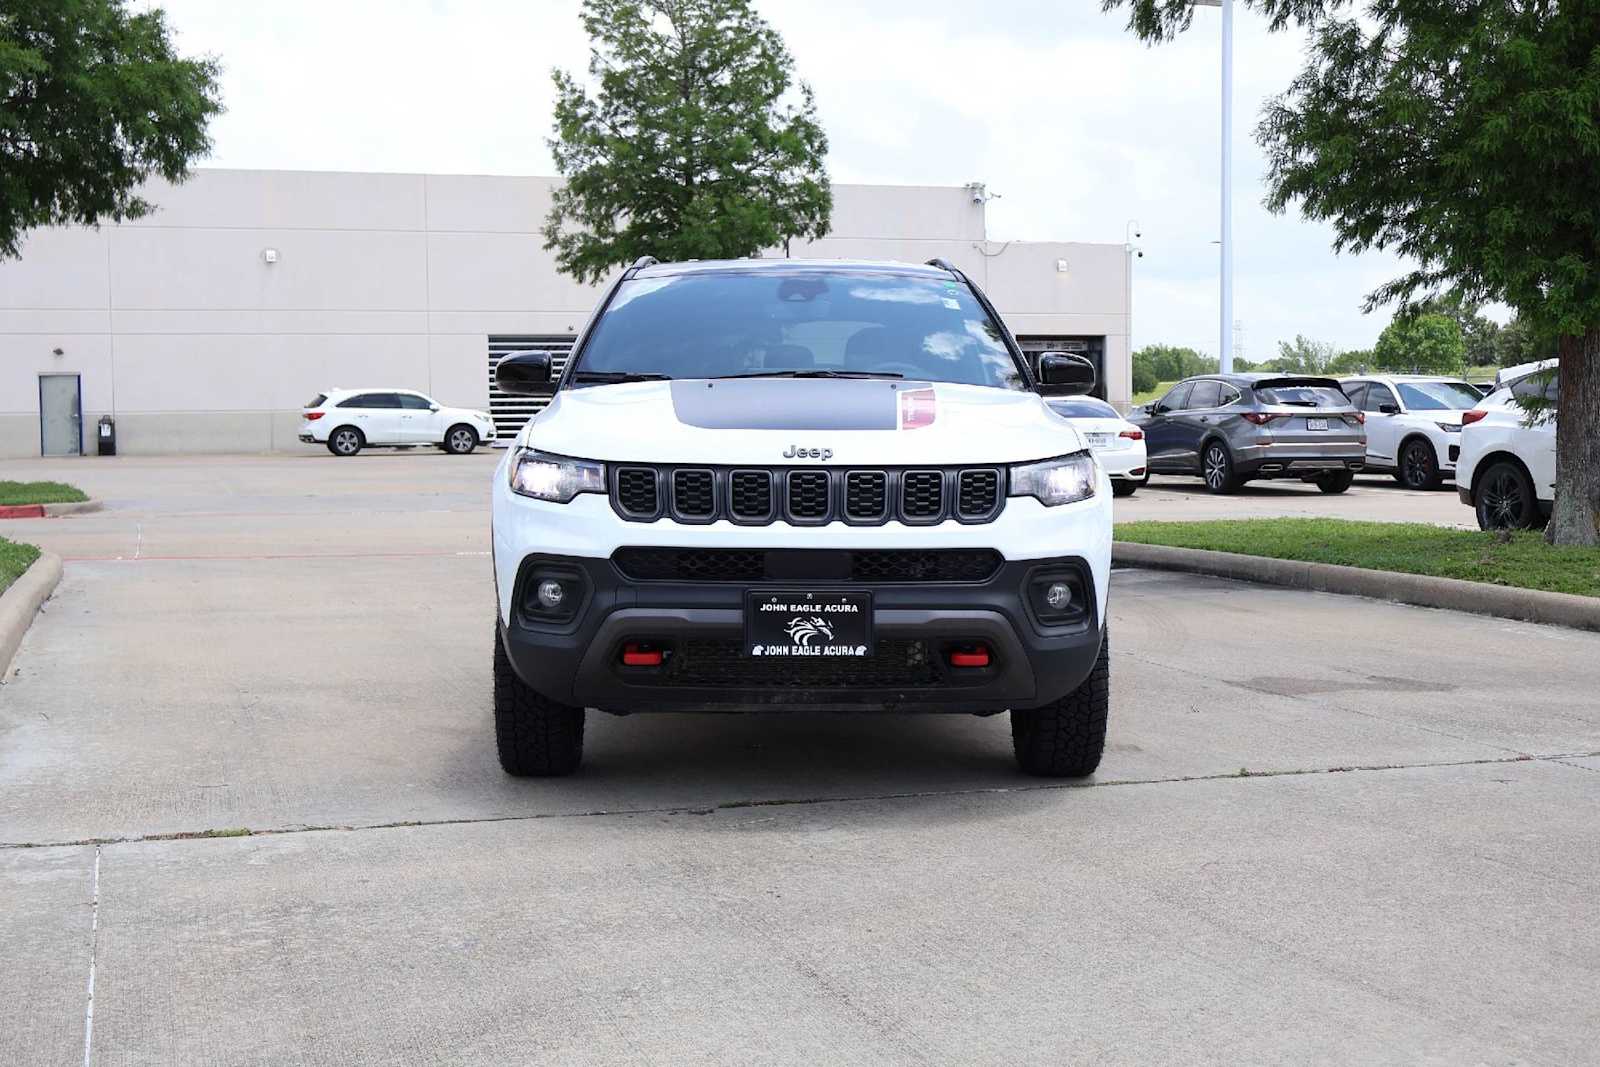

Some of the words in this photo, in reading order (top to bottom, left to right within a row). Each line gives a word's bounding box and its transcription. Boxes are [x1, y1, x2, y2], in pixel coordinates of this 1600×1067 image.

[783, 444, 833, 461] Jeep
[760, 604, 787, 612] JOHN
[790, 604, 822, 612] EAGLE
[824, 604, 858, 613] ACURA
[764, 645, 789, 656] JOHN
[791, 645, 821, 656] EAGLE
[823, 645, 855, 656] ACURA
